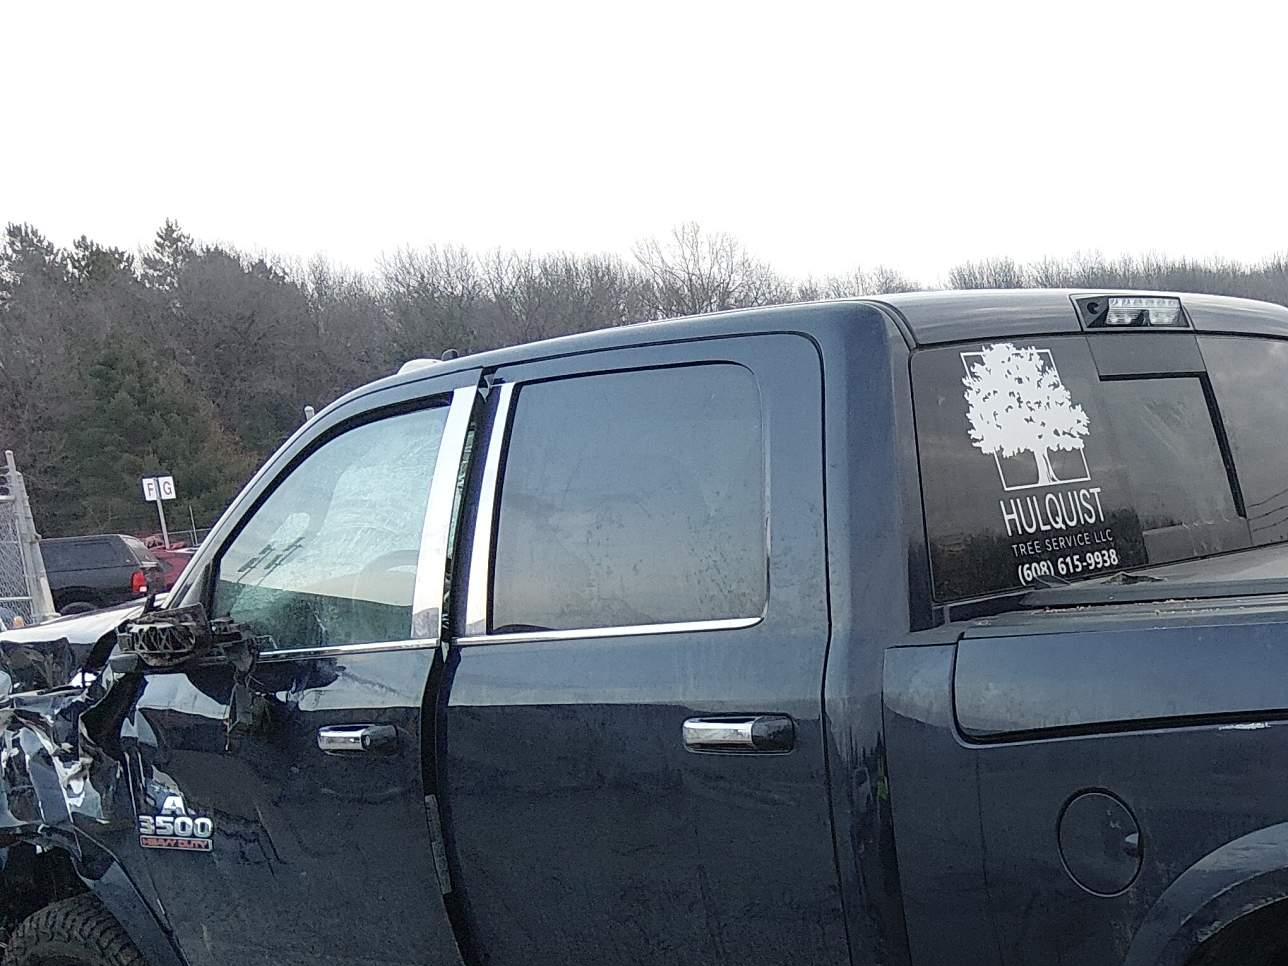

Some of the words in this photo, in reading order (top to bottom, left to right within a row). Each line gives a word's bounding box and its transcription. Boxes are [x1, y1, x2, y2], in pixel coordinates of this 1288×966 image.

[147, 482, 154, 497] F
[163, 480, 173, 496] G
[1000, 487, 1105, 537] HULQUIST
[1012, 540, 1042, 558] TREE
[1045, 532, 1091, 552] SERVICE
[1094, 529, 1114, 544] LLC
[1018, 560, 1055, 586] (608)
[1057, 548, 1119, 576] 615-9938
[138, 815, 213, 838] 3500
